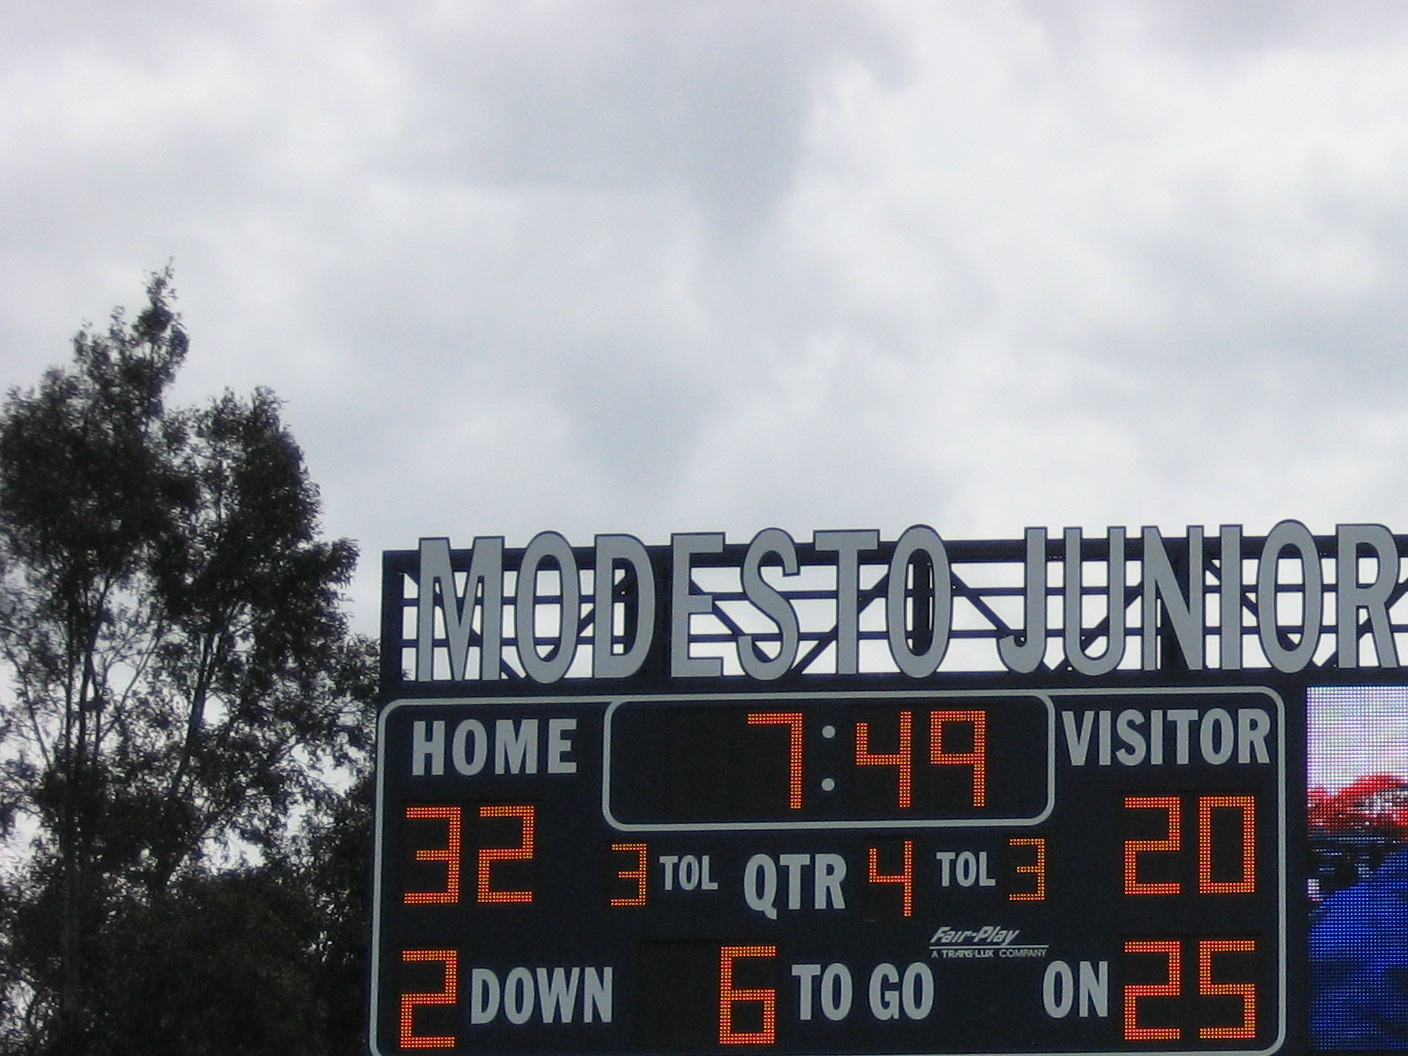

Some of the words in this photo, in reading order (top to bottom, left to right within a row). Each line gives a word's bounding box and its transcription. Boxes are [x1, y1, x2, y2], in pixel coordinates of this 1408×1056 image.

[416, 524, 954, 684] MODESTO
[998, 519, 1401, 677] JUNIOR
[411, 718, 578, 776] HOME
[747, 710, 986, 810] 7:49
[1062, 707, 1272, 766] VISITOR
[403, 805, 535, 905] 32
[610, 842, 647, 907] 3
[659, 855, 718, 892] TOL
[936, 851, 996, 888] TOL
[1008, 838, 1045, 901] 3
[1124, 795, 1256, 895] 20
[743, 853, 848, 920] QTR
[867, 840, 913, 918] 4
[929, 925, 1020, 946] Fair-Play
[931, 950, 939, 958] A
[998, 948, 1047, 958] COMPANY
[400, 949, 458, 1049] 2
[470, 966, 614, 1026] DOWN
[719, 945, 777, 1046] 6
[791, 963, 854, 1021] TO
[868, 962, 935, 1020] GO
[1042, 959, 1109, 1019] ON
[1124, 939, 1256, 1040] 25
